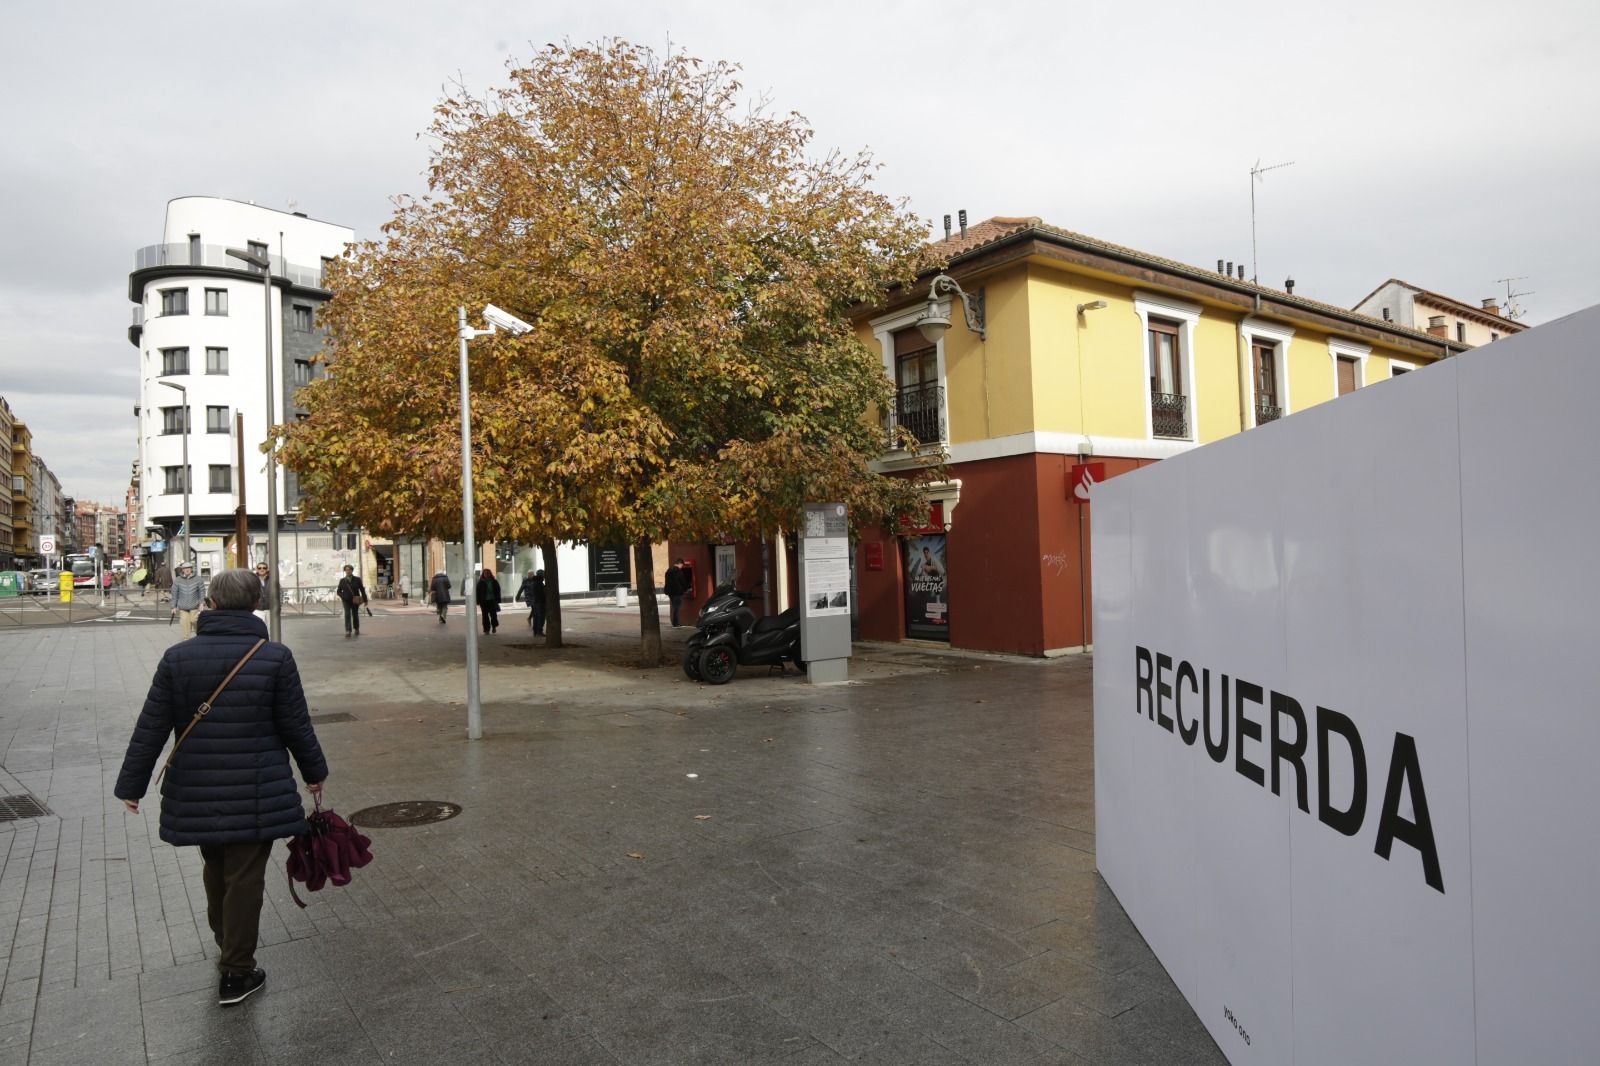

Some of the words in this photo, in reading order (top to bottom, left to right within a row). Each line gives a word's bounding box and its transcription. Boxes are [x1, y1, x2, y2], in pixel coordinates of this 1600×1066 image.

[911, 581, 944, 593] VUELTAS
[1136, 645, 1445, 895] RECUERDA
[1223, 1004, 1238, 1029] yoko
[1238, 1025, 1251, 1046] ono
